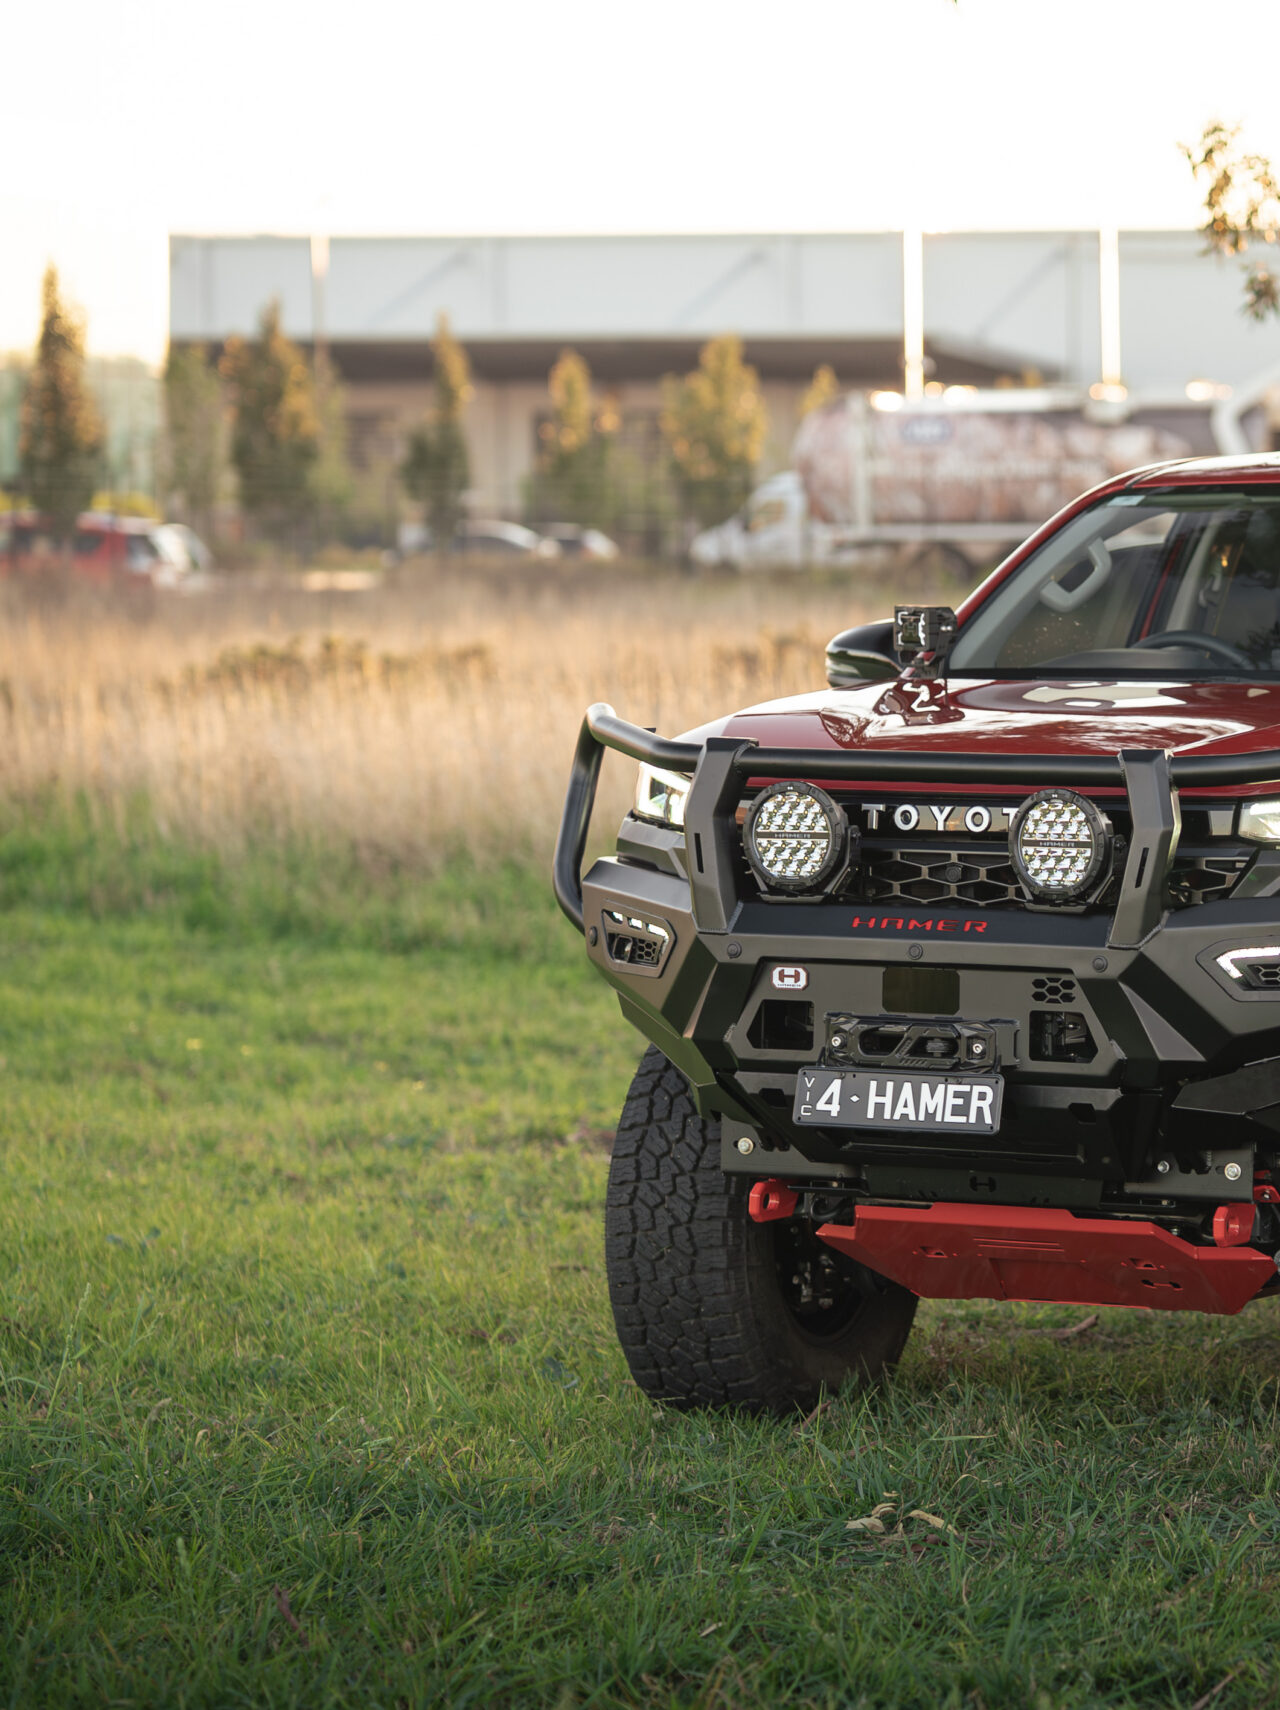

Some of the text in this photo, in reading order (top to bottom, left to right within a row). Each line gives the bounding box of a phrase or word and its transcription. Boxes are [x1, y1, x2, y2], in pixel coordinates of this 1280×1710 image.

[852, 916, 988, 933] HAMER
[816, 1078, 993, 1125] 4 HAMER
